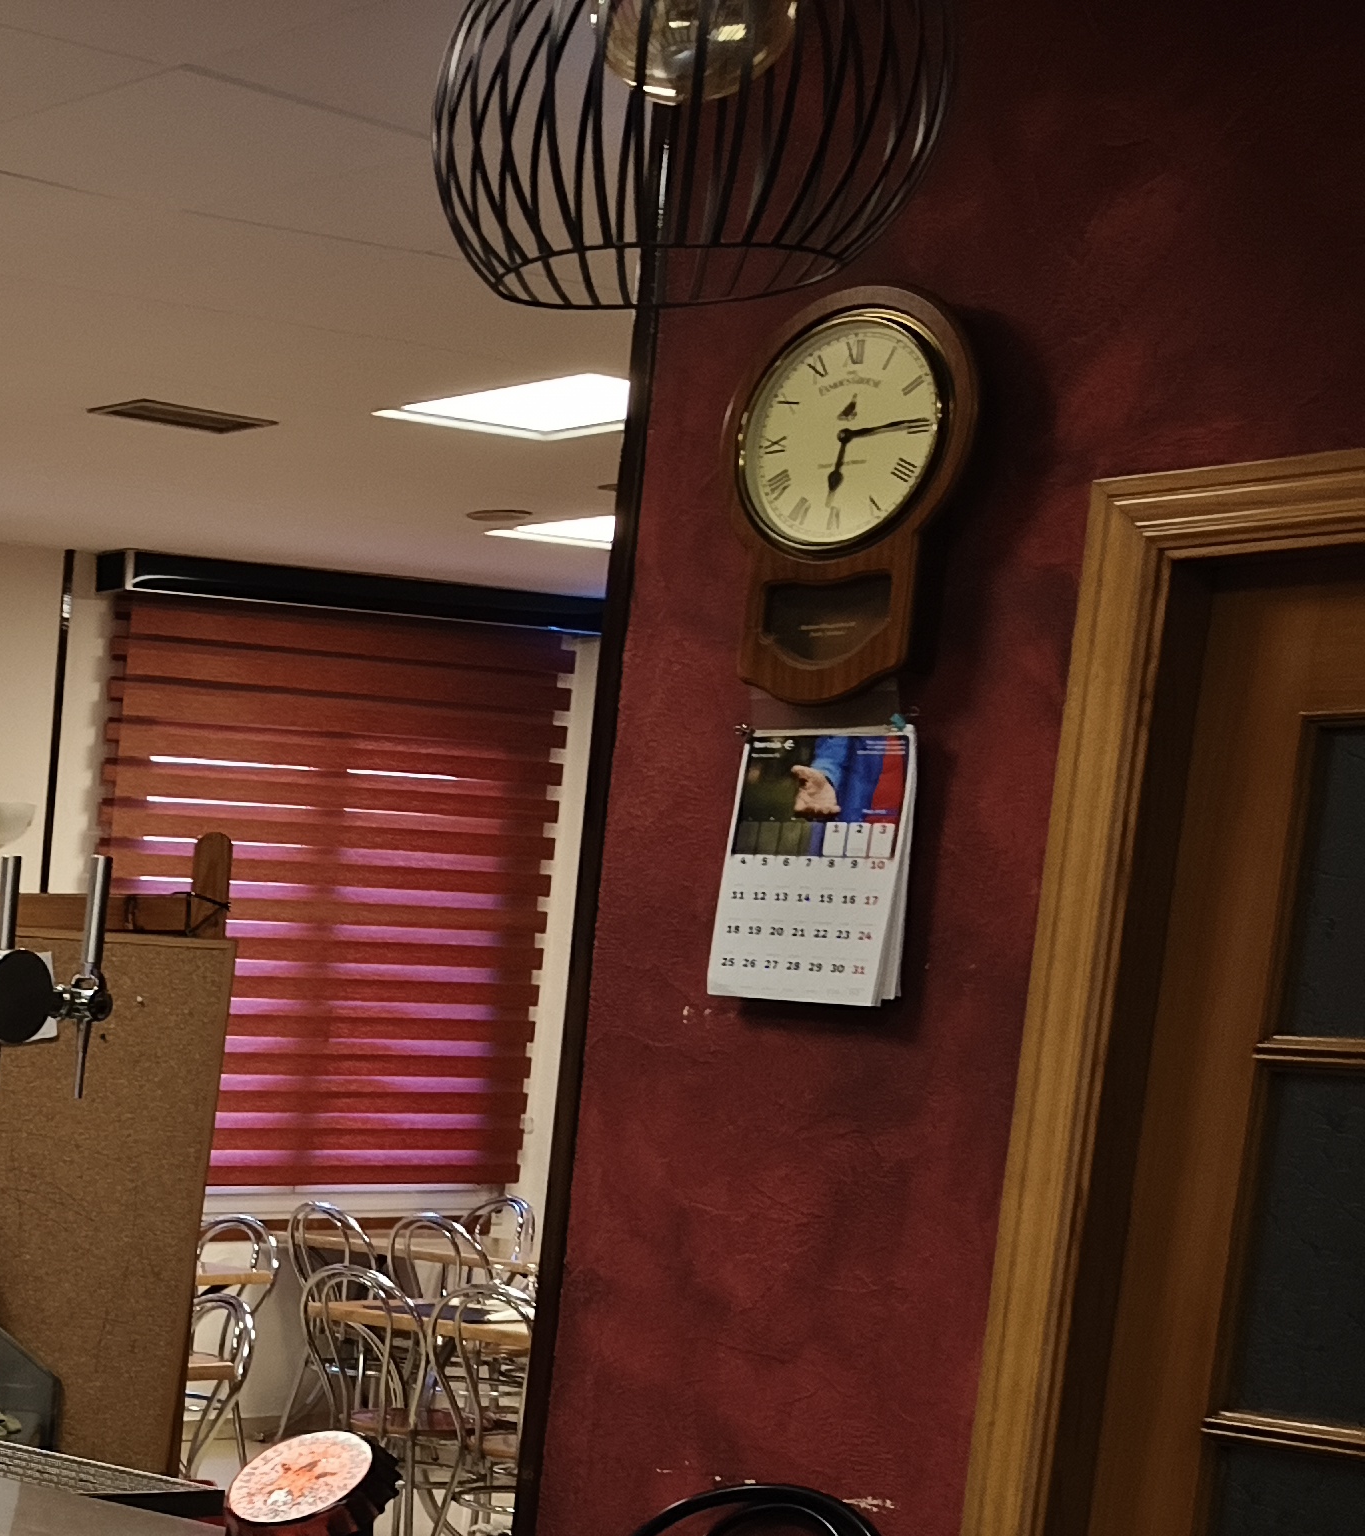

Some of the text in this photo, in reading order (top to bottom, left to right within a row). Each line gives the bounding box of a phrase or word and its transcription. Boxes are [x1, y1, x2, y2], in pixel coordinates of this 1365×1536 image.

[739, 857, 885, 870] 4 5 6 7 8 9 10
[731, 891, 878, 905] 11 12 13 14 15 16 17
[727, 925, 872, 940] 18 19 20 21 22 23 24
[721, 958, 865, 974] 25 26 27 28 29 30 31
